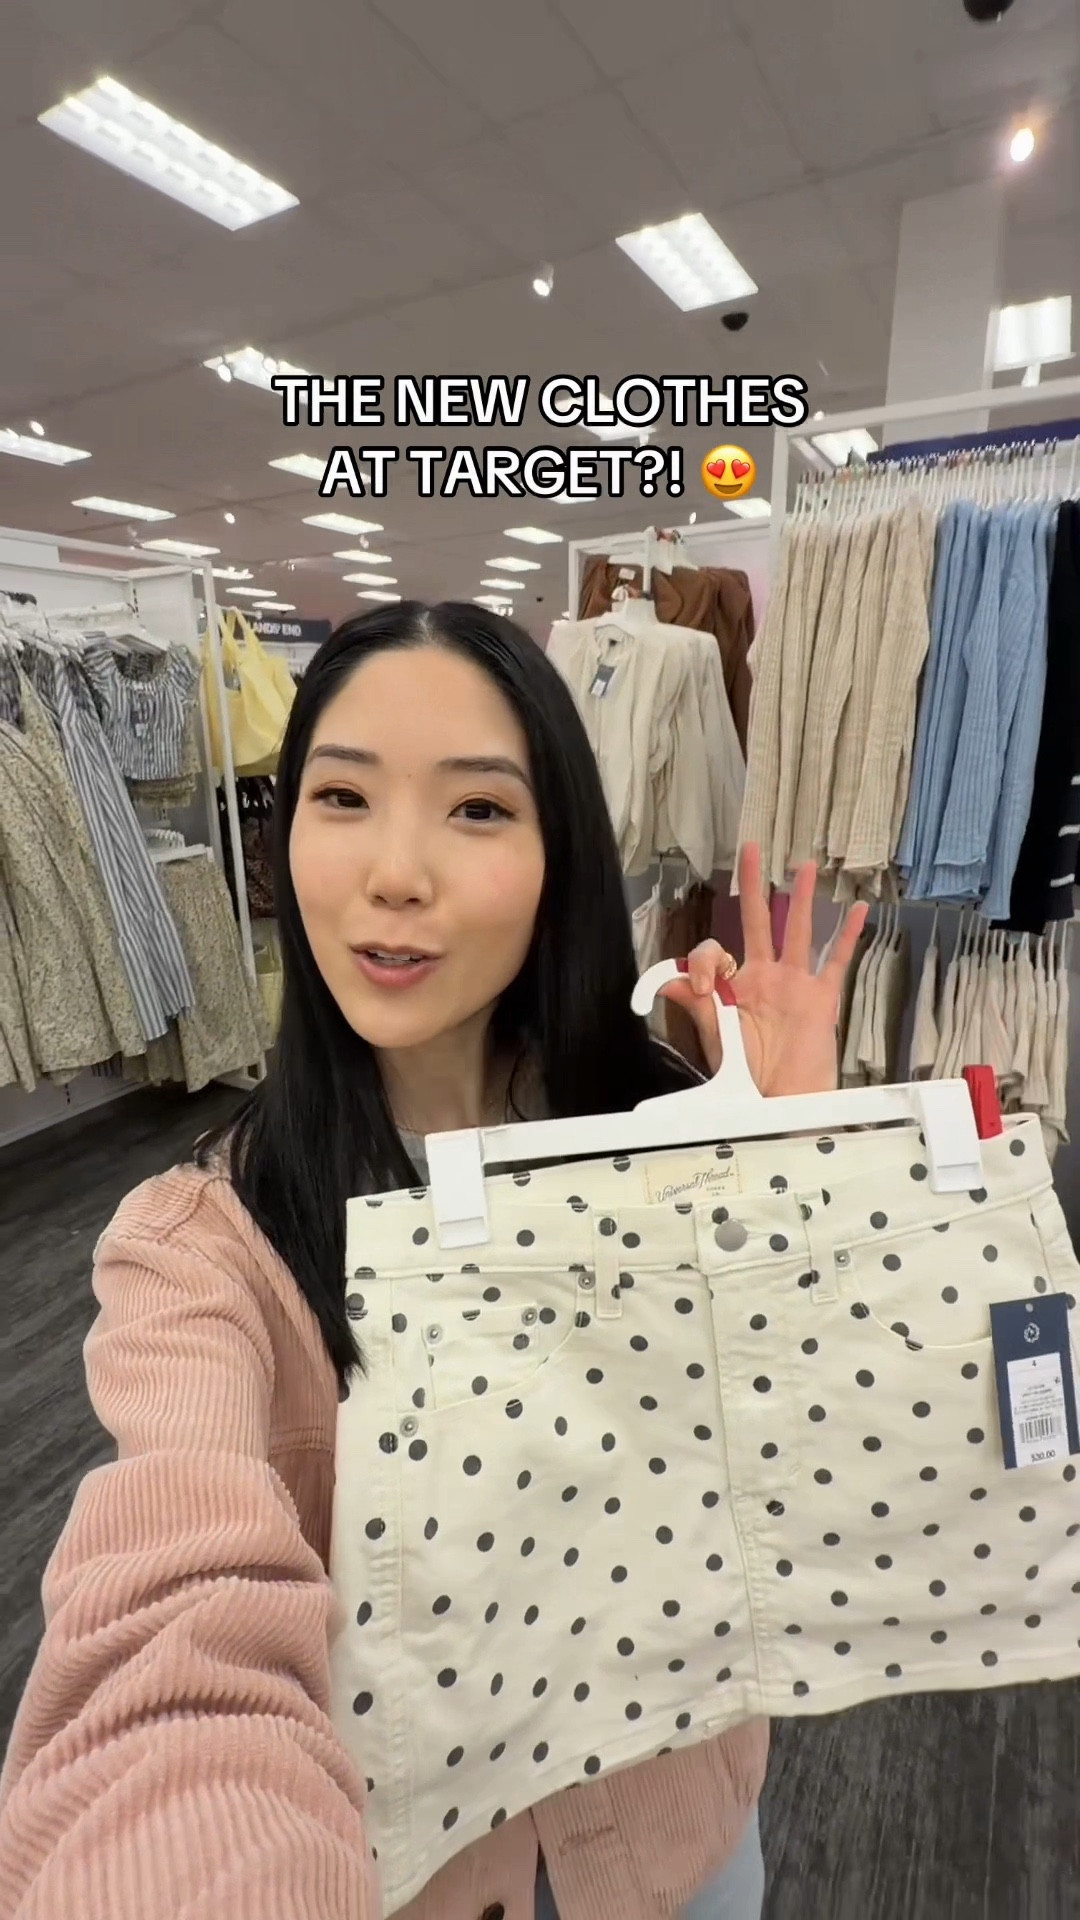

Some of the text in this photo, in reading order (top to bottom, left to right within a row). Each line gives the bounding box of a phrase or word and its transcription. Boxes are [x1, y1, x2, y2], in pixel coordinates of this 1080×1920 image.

[281, 623, 302, 636] END
[656, 1174, 700, 1202] Universal
[1031, 1450, 1056, 1462] $30.00
